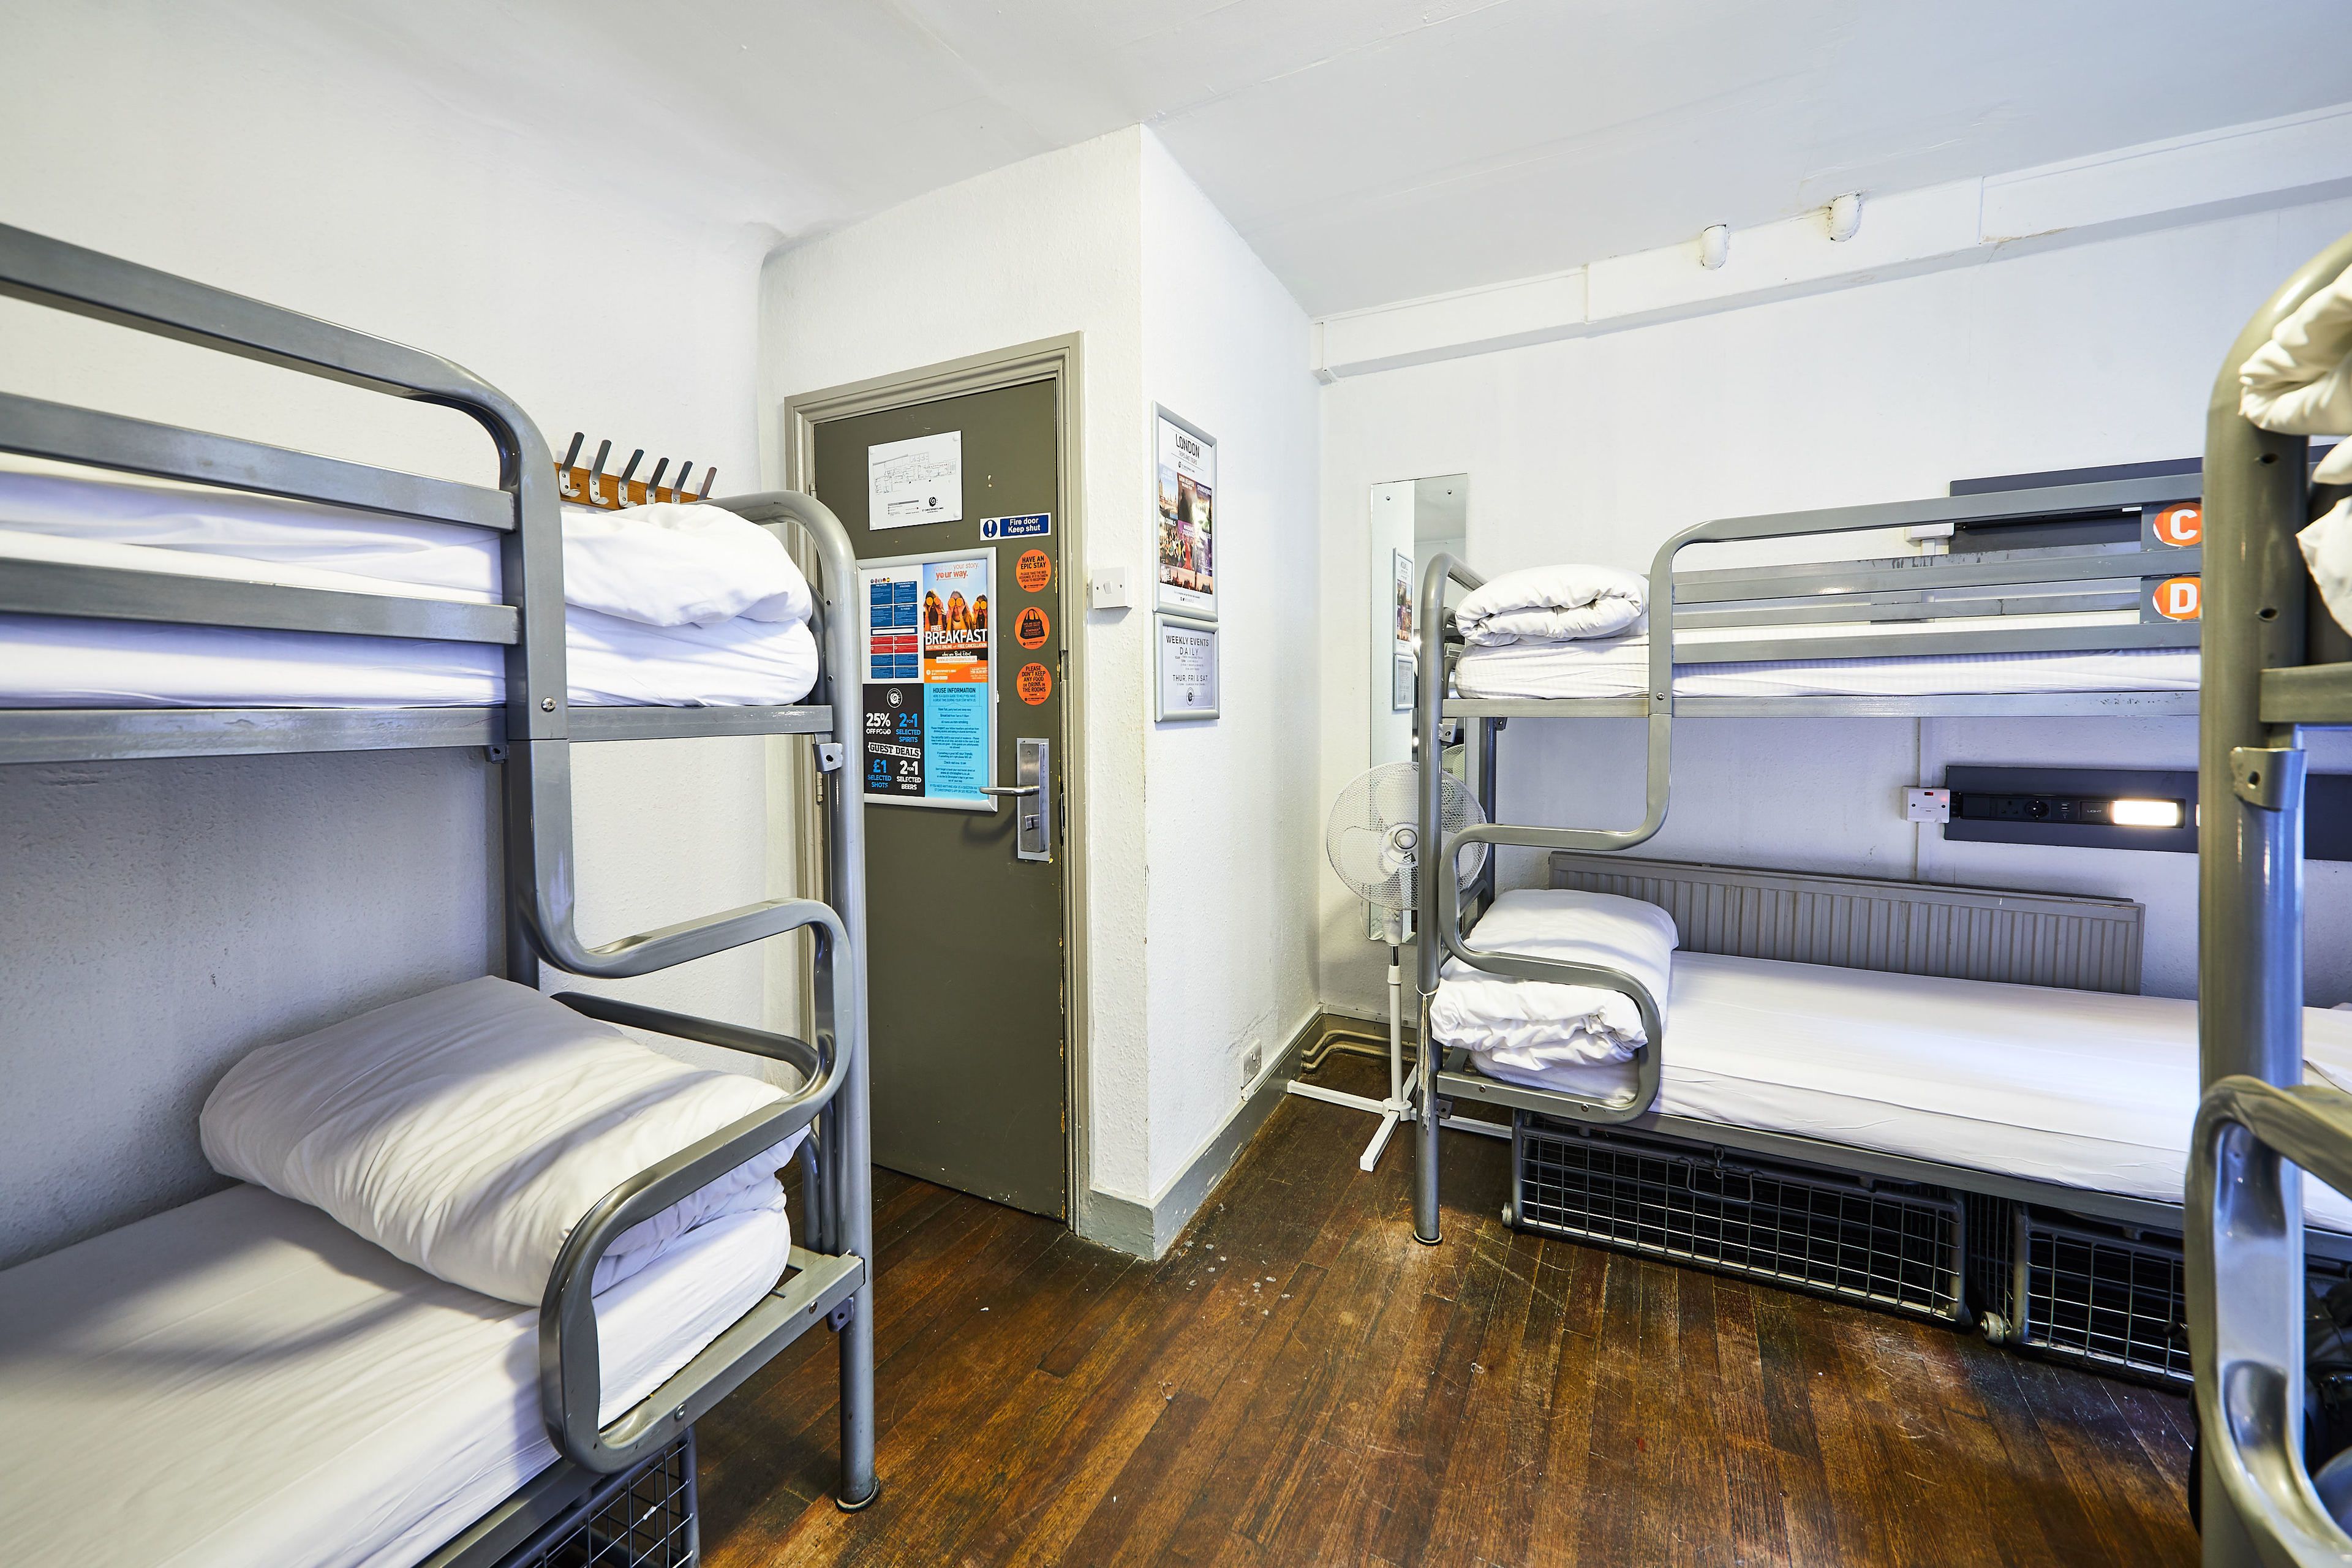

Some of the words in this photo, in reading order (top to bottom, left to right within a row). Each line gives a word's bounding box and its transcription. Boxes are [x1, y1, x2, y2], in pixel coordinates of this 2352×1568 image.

[1175, 434, 1200, 458] LONDON
[1197, 484, 1212, 496] STONEHENGE
[2170, 509, 2198, 540] C
[936, 571, 952, 581] your
[953, 570, 968, 579] way.
[2169, 583, 2197, 614] D
[925, 628, 987, 645] BREAKFAST
[1166, 635, 1189, 645] WEEKLY
[1190, 637, 1209, 646] EVENTS
[1180, 647, 1199, 656] DAILY
[866, 713, 891, 727] 25%
[870, 743, 893, 754] GUEST
[896, 747, 919, 757] DEALS
[873, 759, 886, 773] £1
